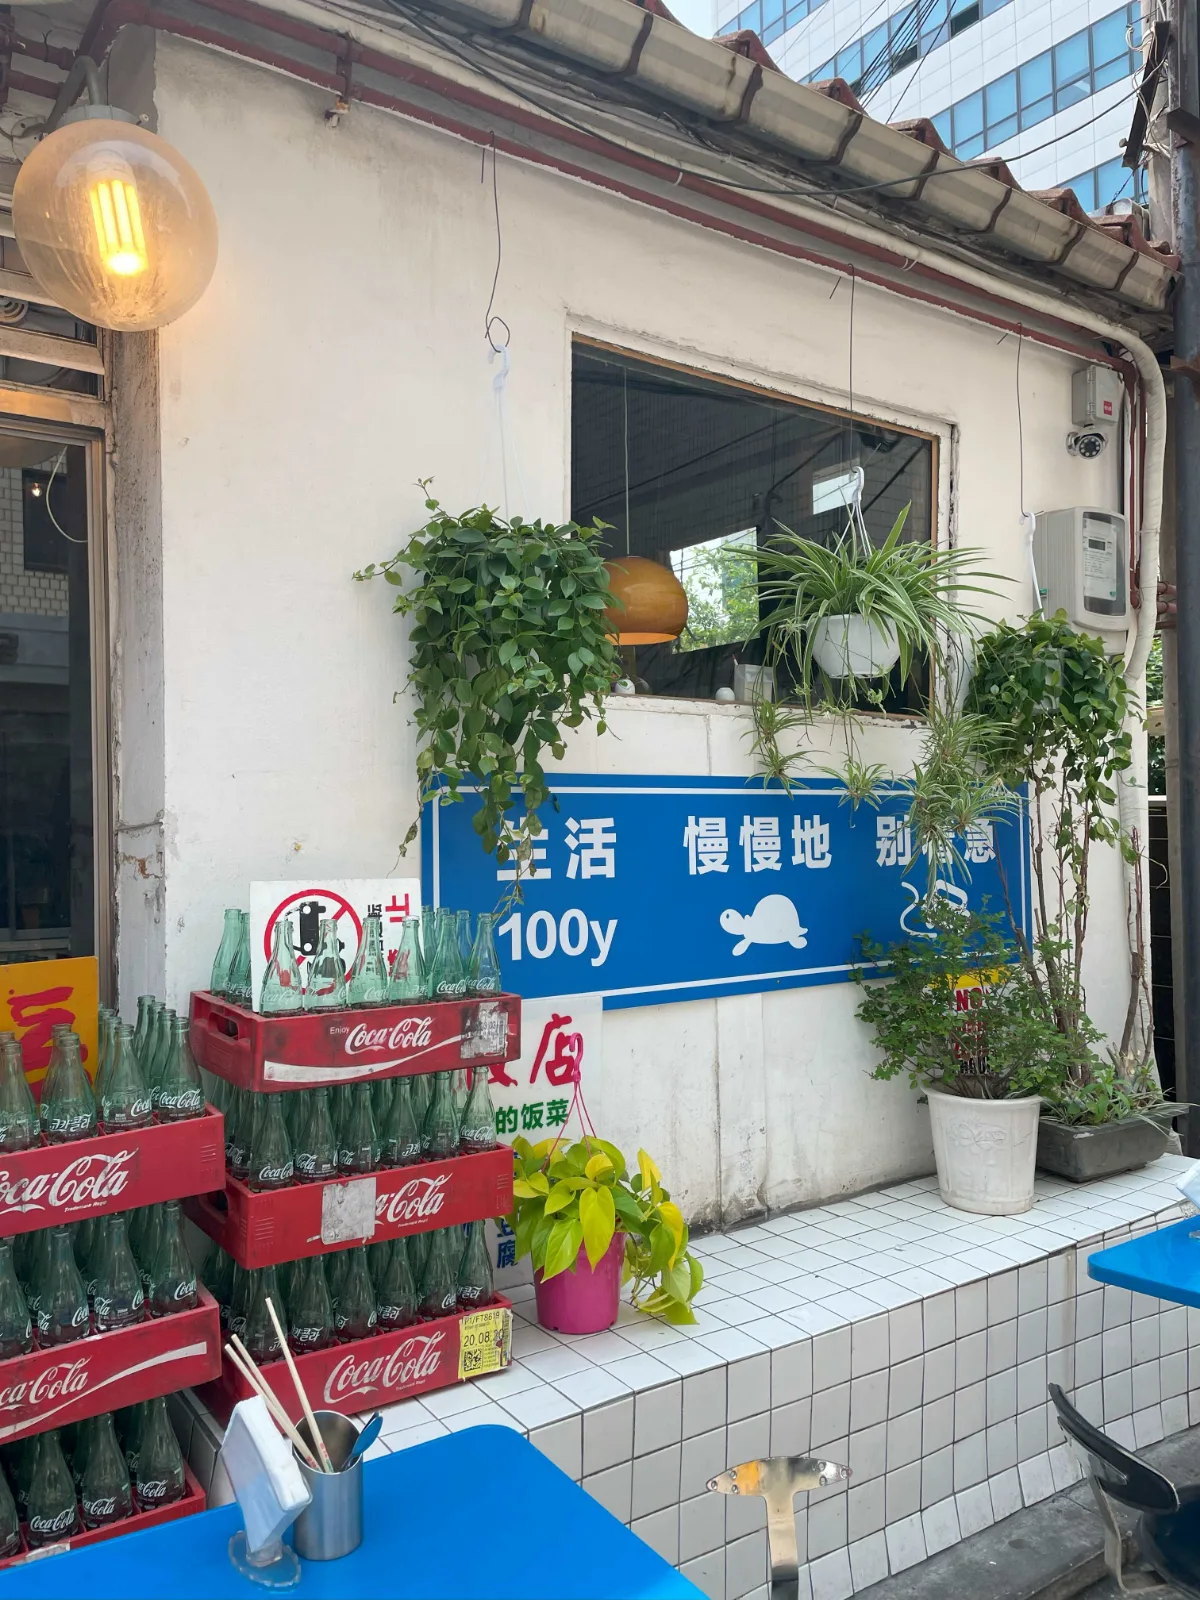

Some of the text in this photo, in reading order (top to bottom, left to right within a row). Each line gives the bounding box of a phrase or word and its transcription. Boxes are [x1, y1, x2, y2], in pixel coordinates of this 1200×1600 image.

[497, 817, 617, 881] 生活
[683, 814, 832, 875] 慢慢地
[498, 908, 619, 967] 100y
[330, 1016, 435, 1055] Enjoy Coca-Cola
[159, 1088, 202, 1109] Coca-Cola
[496, 1099, 570, 1135] 的饭菜
[460, 1125, 493, 1141] Coca-Cola
[323, 1331, 446, 1404] Coca-Cola
[30, 1505, 75, 1532] Coca-Cola
